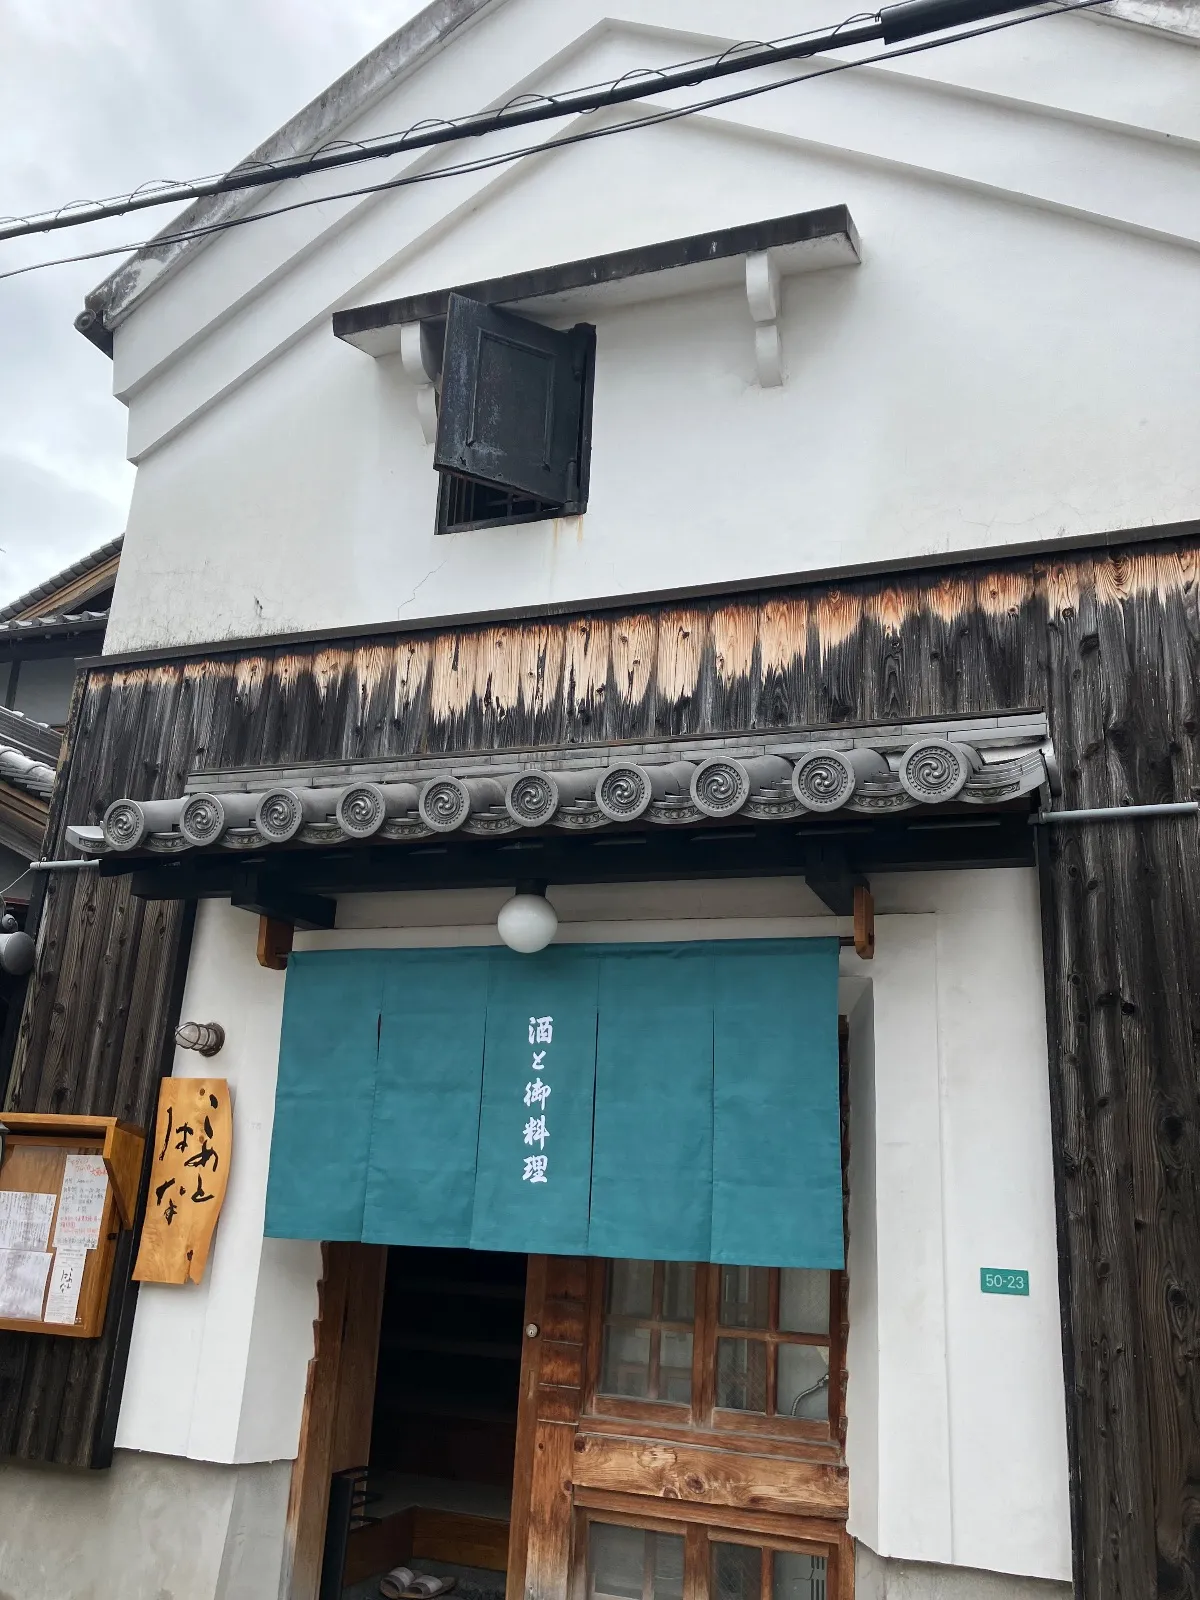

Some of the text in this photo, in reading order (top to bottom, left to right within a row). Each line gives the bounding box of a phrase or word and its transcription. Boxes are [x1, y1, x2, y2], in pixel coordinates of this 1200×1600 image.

[521, 1015, 554, 1184] 酒と御料理
[985, 1273, 1025, 1289] 50-23
